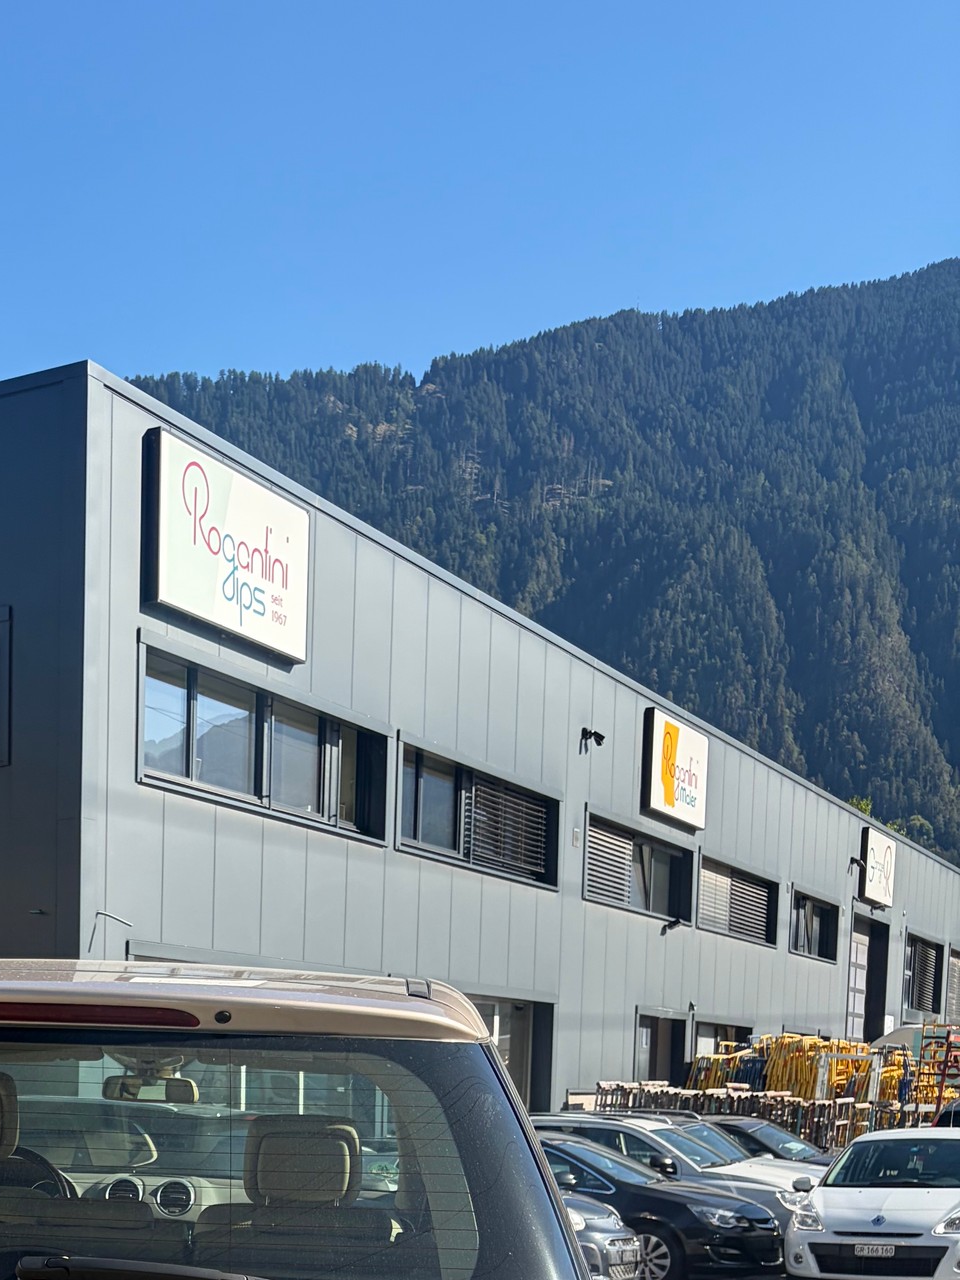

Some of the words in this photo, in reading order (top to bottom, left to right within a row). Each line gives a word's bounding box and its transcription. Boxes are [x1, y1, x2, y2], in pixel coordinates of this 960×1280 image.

[182, 461, 288, 590] Rogantini
[271, 594, 283, 608] seit
[271, 610, 287, 626] 1967
[867, 1246, 880, 1255] 166
[881, 1246, 894, 1255] 160
